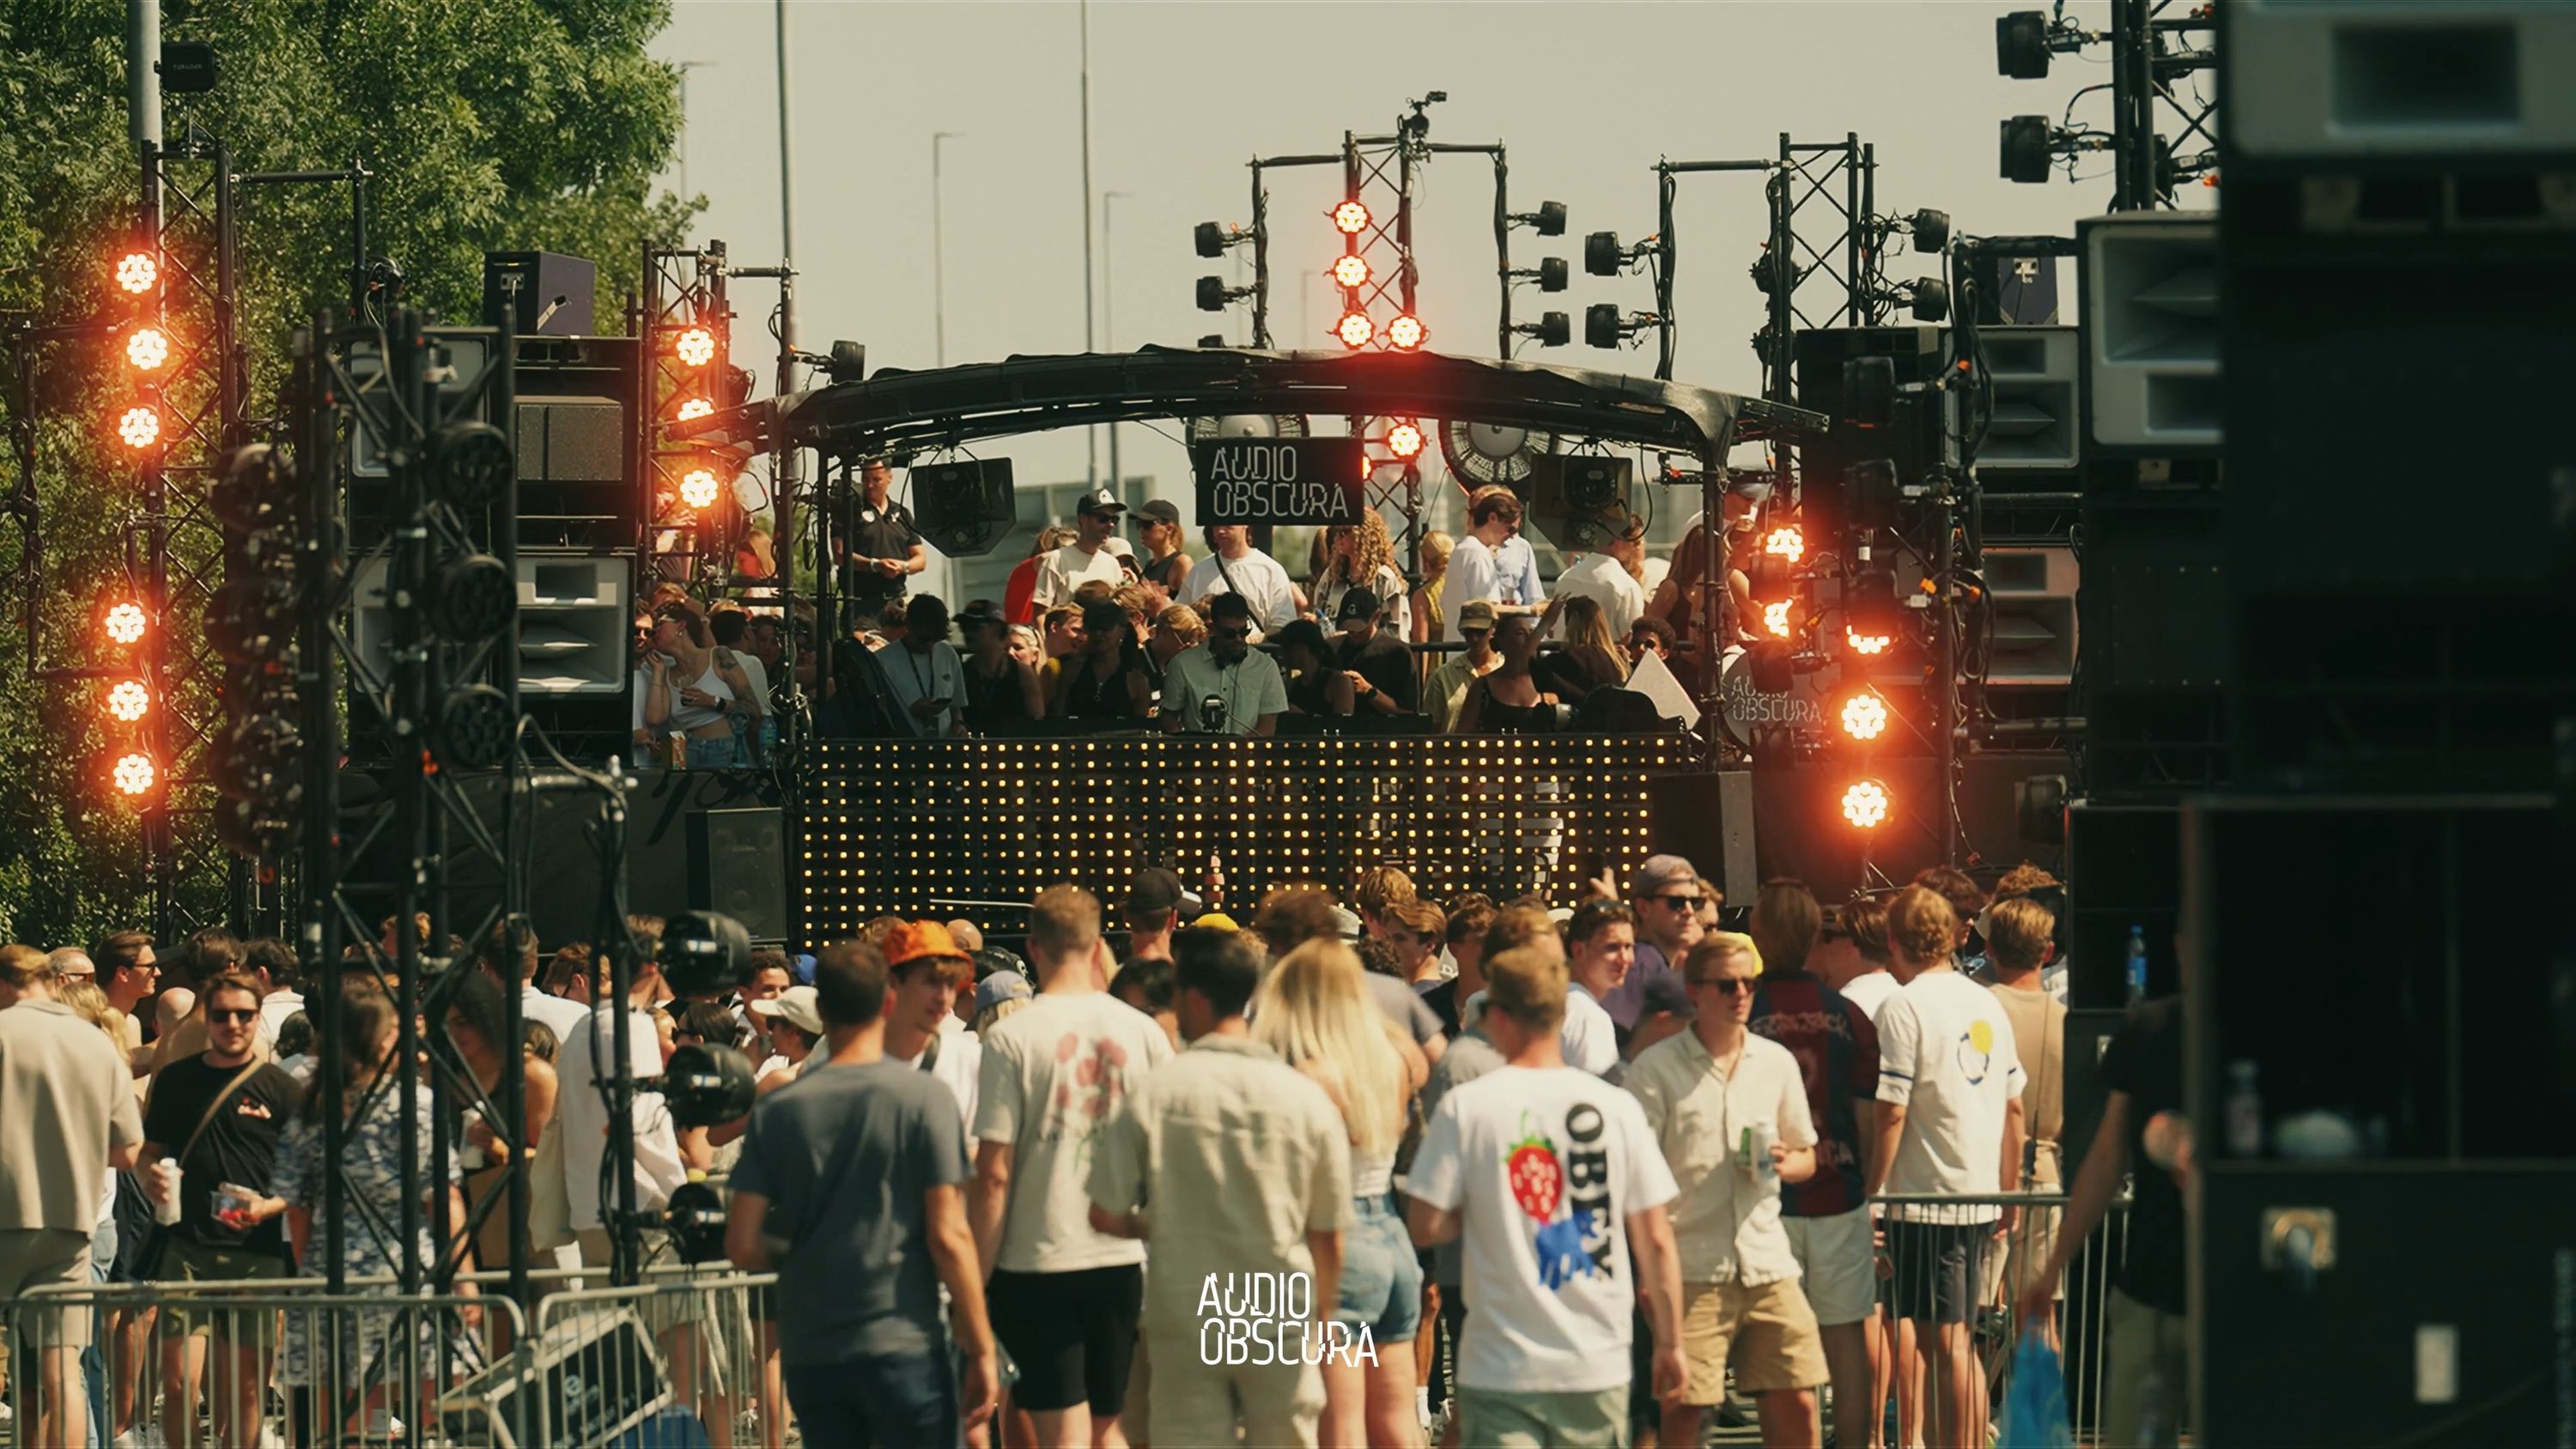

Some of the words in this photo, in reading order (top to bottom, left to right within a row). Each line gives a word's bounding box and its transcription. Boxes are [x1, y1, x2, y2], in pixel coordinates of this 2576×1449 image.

[1211, 446, 1297, 482] AUDIO
[1213, 482, 1349, 518] OBSCURA
[1732, 697, 1822, 723] OBSCURA
